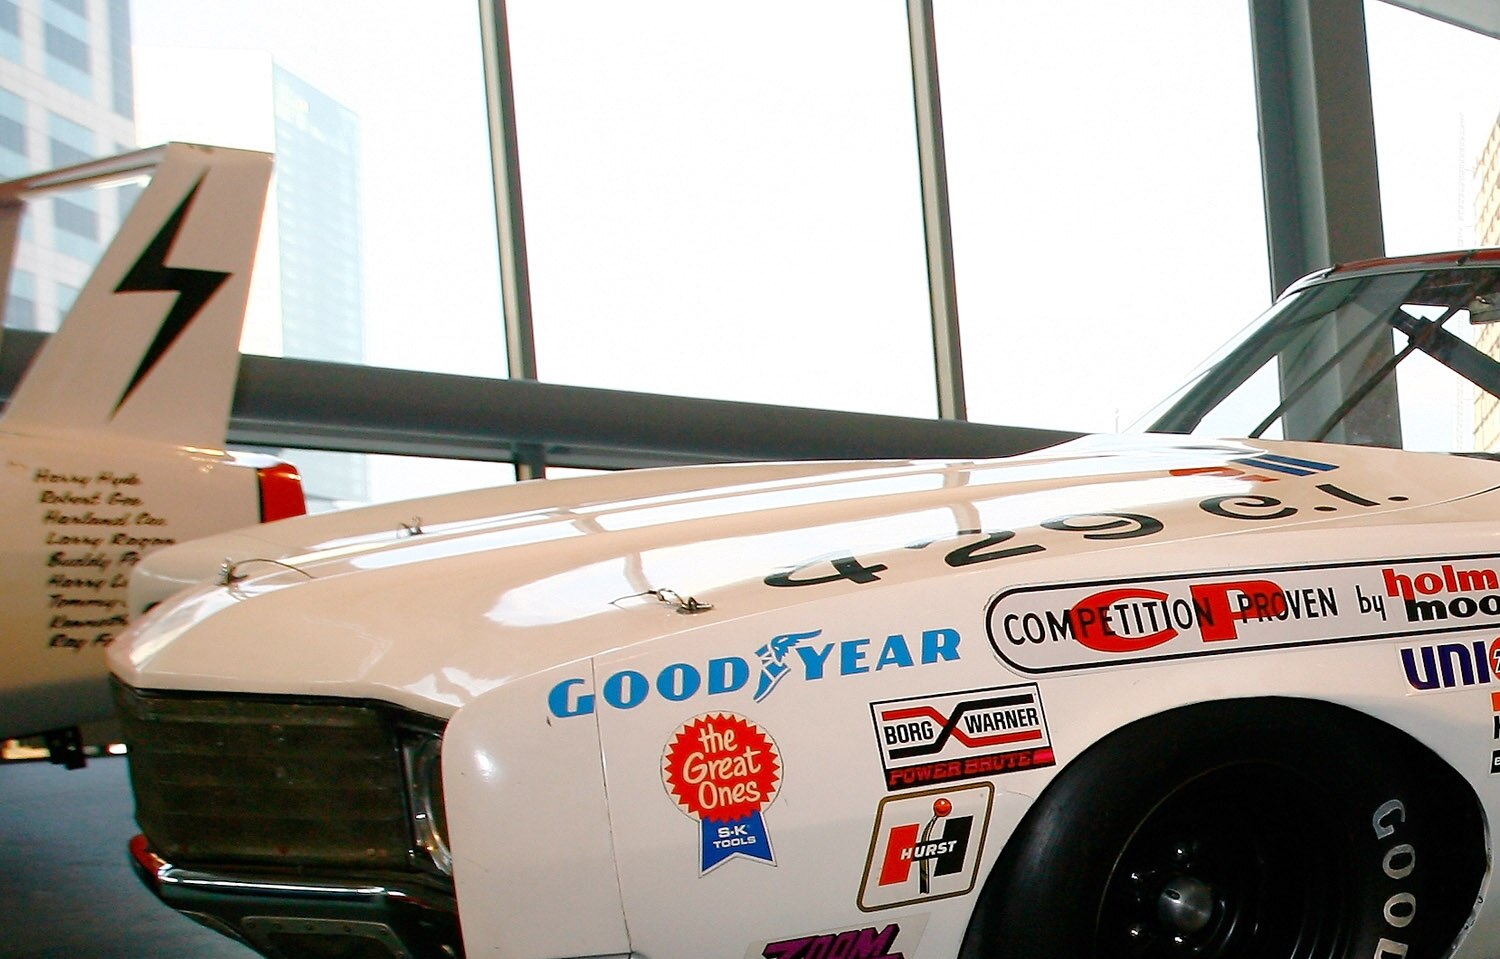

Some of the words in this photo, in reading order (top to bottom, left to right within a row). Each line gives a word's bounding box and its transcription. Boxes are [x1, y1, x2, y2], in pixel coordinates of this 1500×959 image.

[1003, 597, 1213, 645] COMPETITION
[1240, 587, 1339, 625] PROVEN
[1357, 584, 1386, 622] by
[698, 724, 738, 753] the
[883, 720, 934, 745] BORG
[964, 708, 1039, 734] WARNER
[683, 746, 761, 784] Great
[888, 763, 962, 786] POWER
[964, 752, 1031, 774] BRUTE
[699, 781, 760, 809] Ones
[713, 836, 756, 848] TOOLS
[900, 840, 957, 860] HURST
